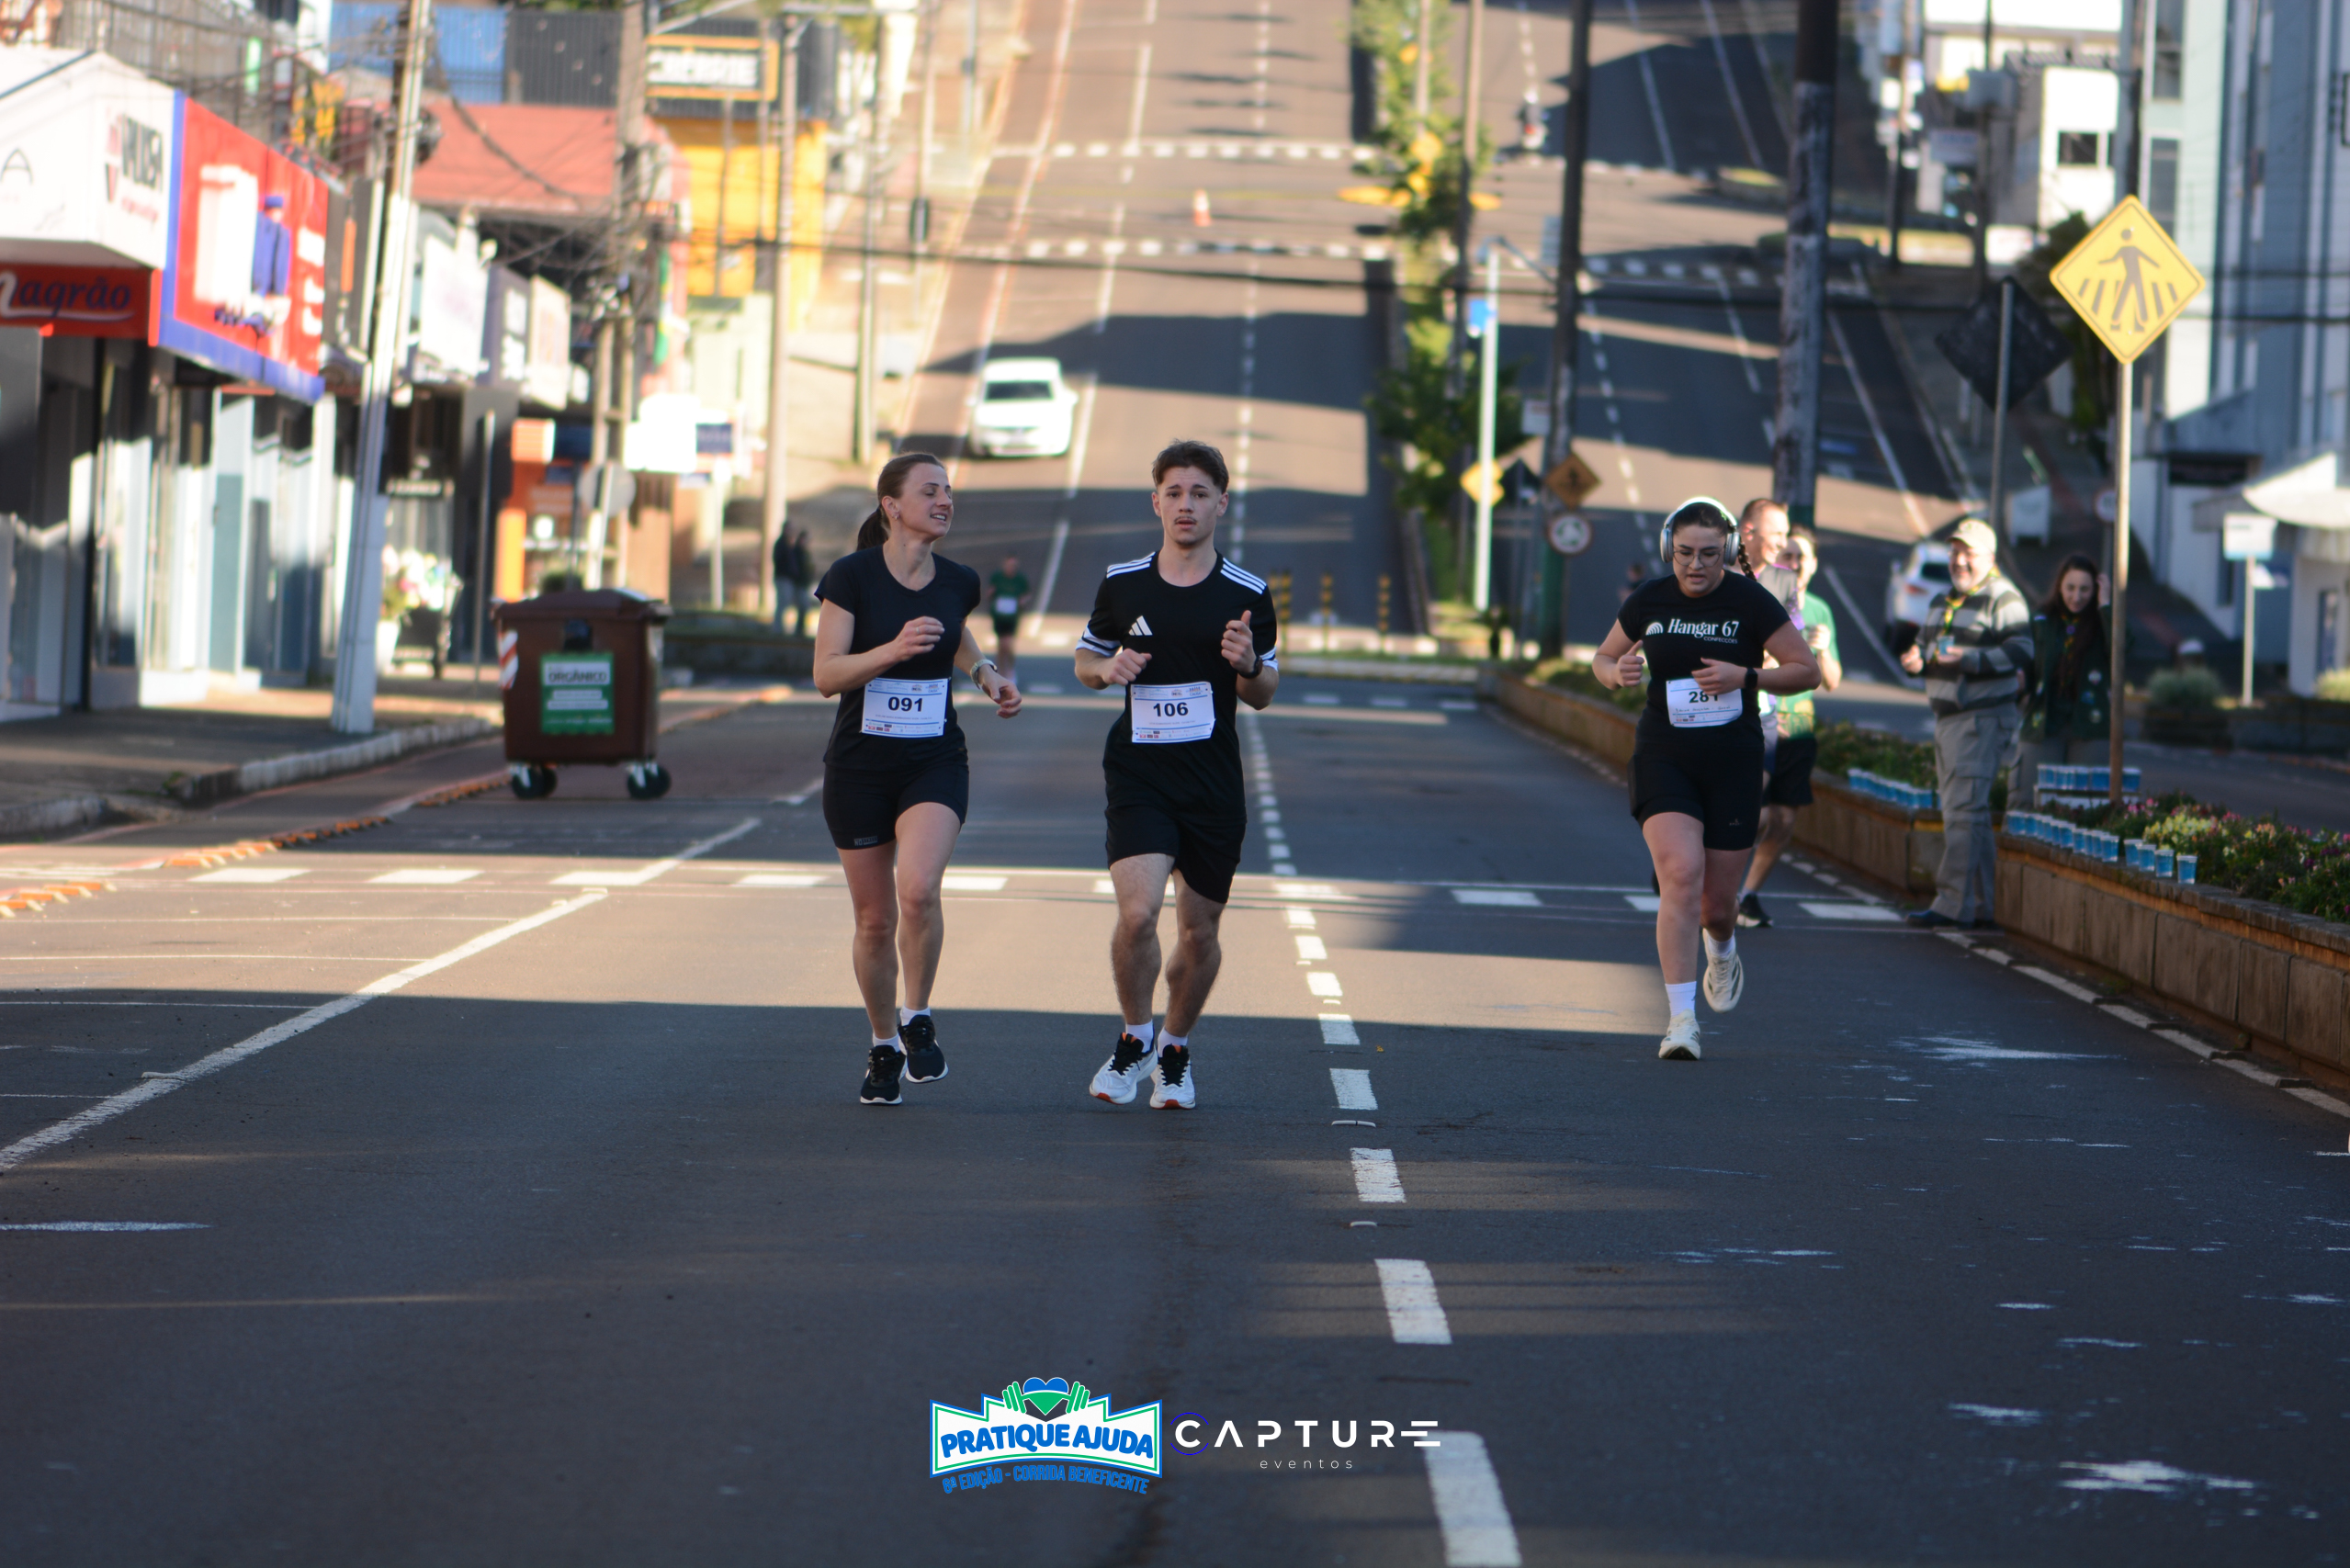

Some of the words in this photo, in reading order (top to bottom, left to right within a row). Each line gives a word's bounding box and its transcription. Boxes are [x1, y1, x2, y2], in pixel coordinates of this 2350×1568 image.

[1667, 618, 1719, 638] Hangar
[1722, 621, 1739, 637] 67
[888, 696, 922, 712] 091
[1153, 702, 1189, 716] 106
